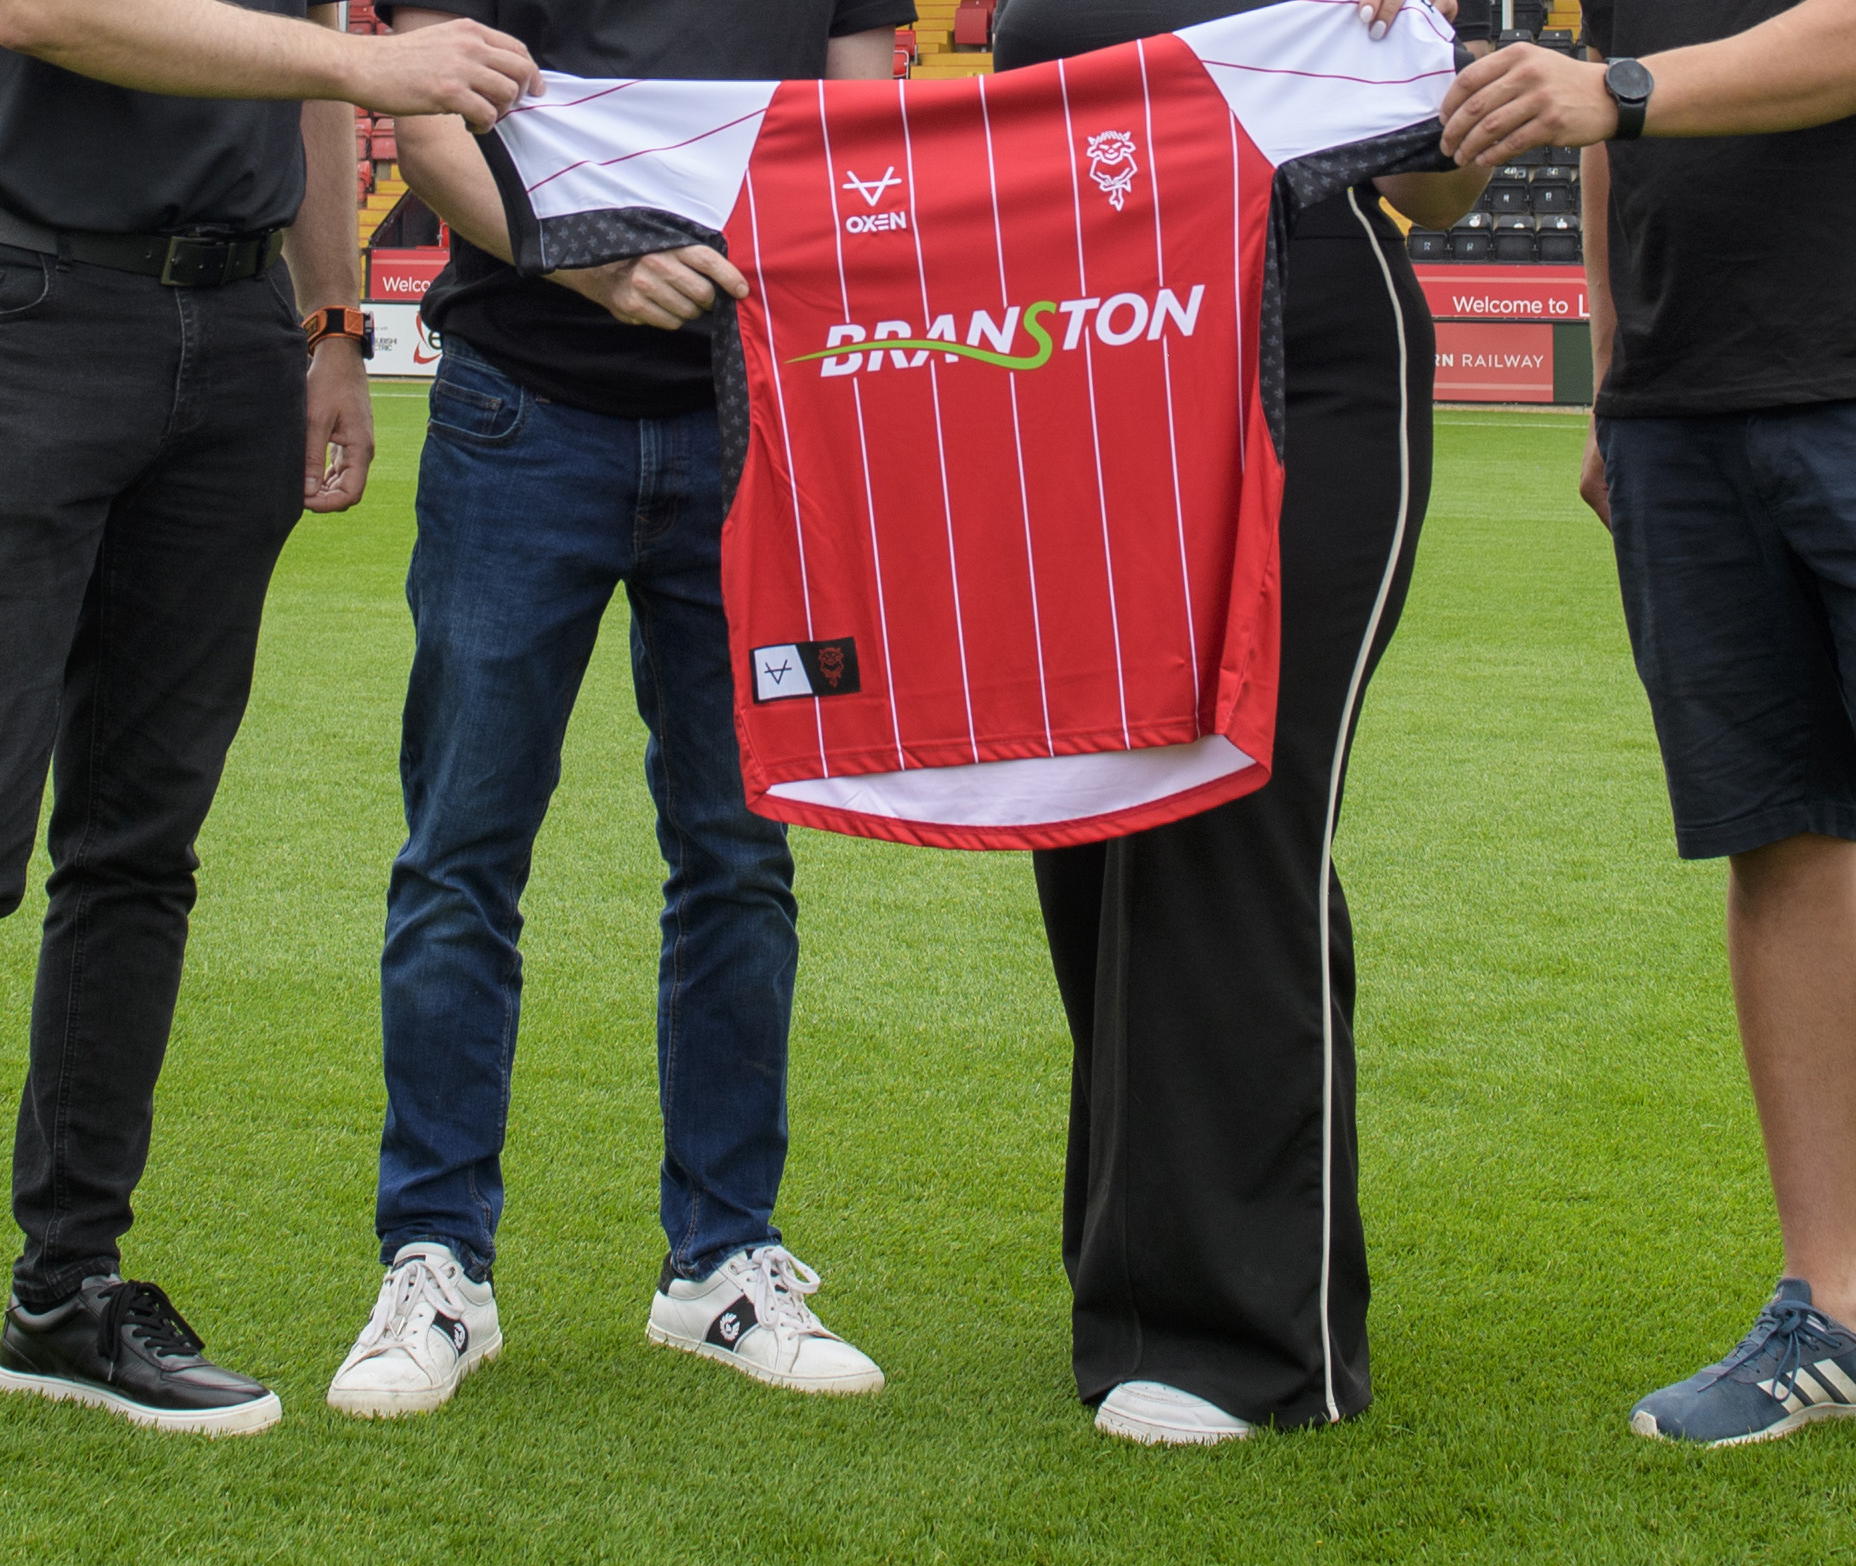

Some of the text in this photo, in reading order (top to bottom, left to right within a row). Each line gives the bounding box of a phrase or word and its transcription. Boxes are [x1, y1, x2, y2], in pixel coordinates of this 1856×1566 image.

[846, 211, 906, 234] OXEN
[1452, 295, 1543, 314] Welcome
[1548, 297, 1569, 315] to
[808, 284, 1205, 377] BRANSTON
[1462, 353, 1544, 369] RAILWAY
